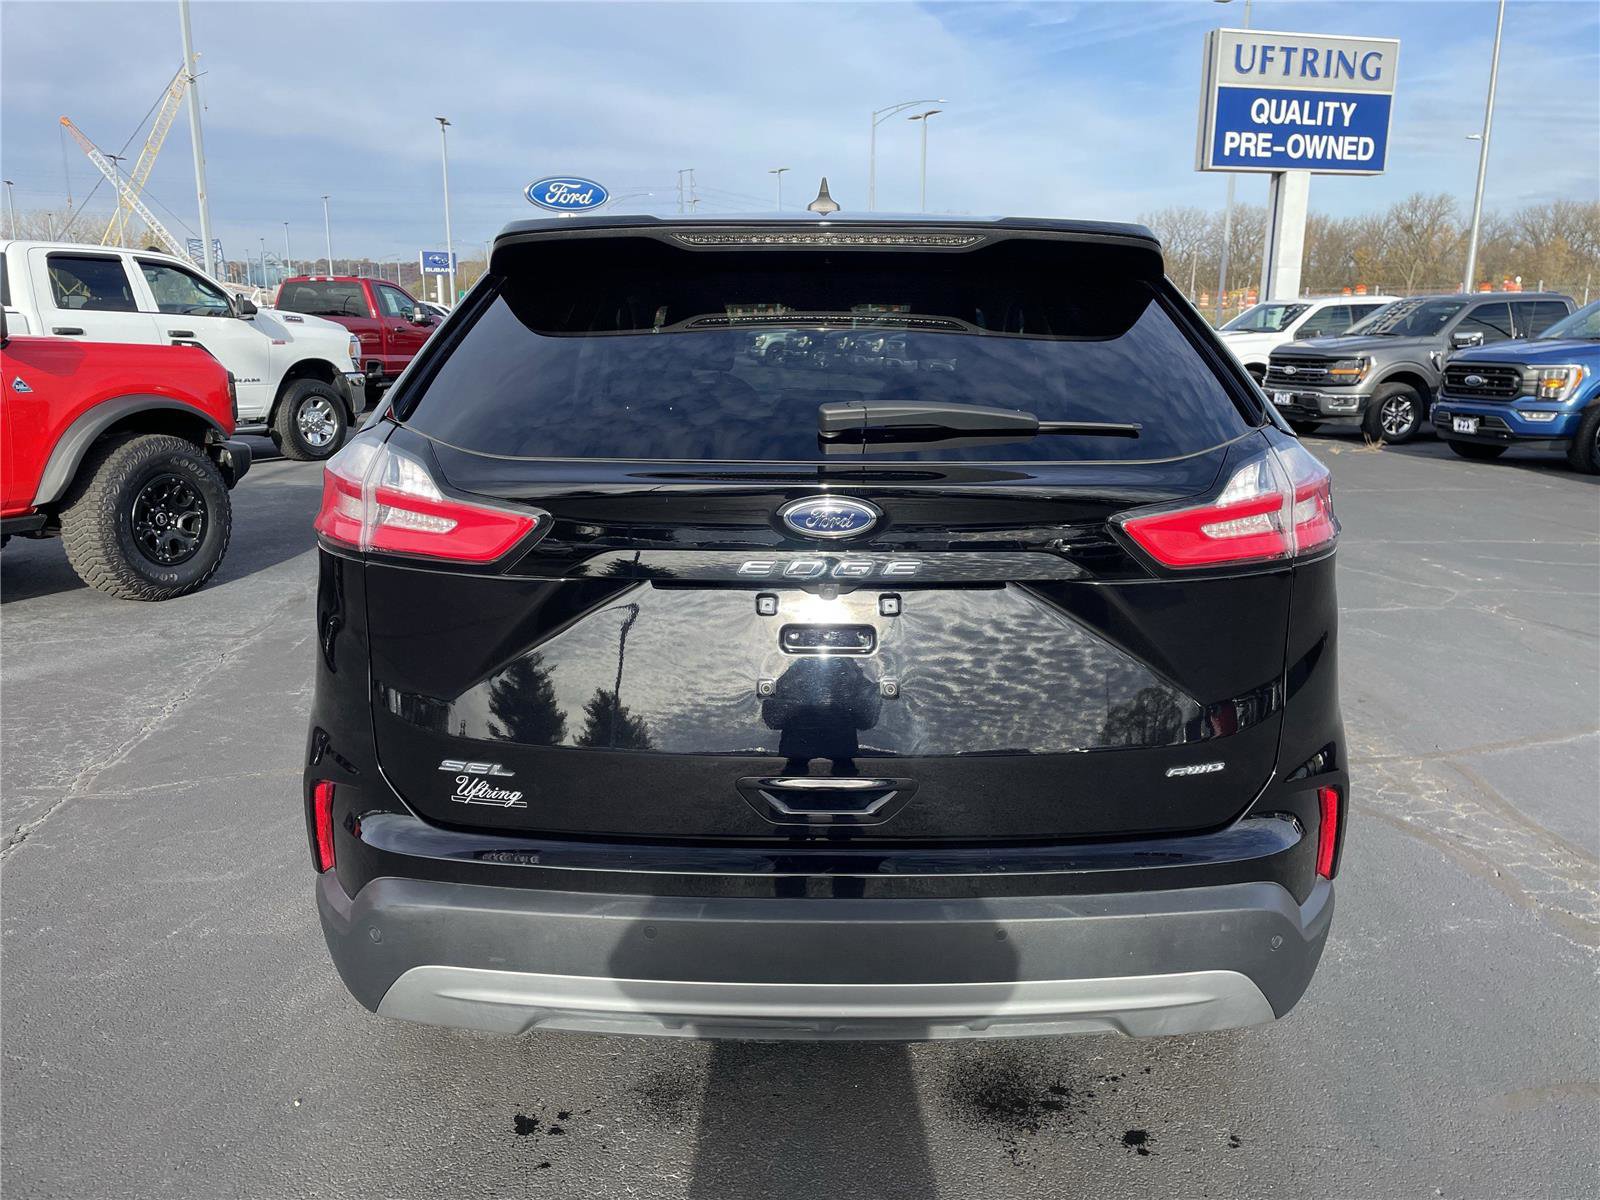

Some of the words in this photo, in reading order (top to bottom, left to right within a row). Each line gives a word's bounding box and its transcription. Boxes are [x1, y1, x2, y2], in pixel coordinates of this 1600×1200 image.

[1234, 43, 1384, 82] UFTRING
[1250, 97, 1358, 127] QUALITY
[1223, 131, 1375, 161] PRE-OWNED
[545, 182, 594, 205] Ford
[805, 506, 854, 529] Ford
[736, 559, 923, 578] EDGE
[438, 759, 516, 777] SEL
[455, 775, 523, 808] Uftring
